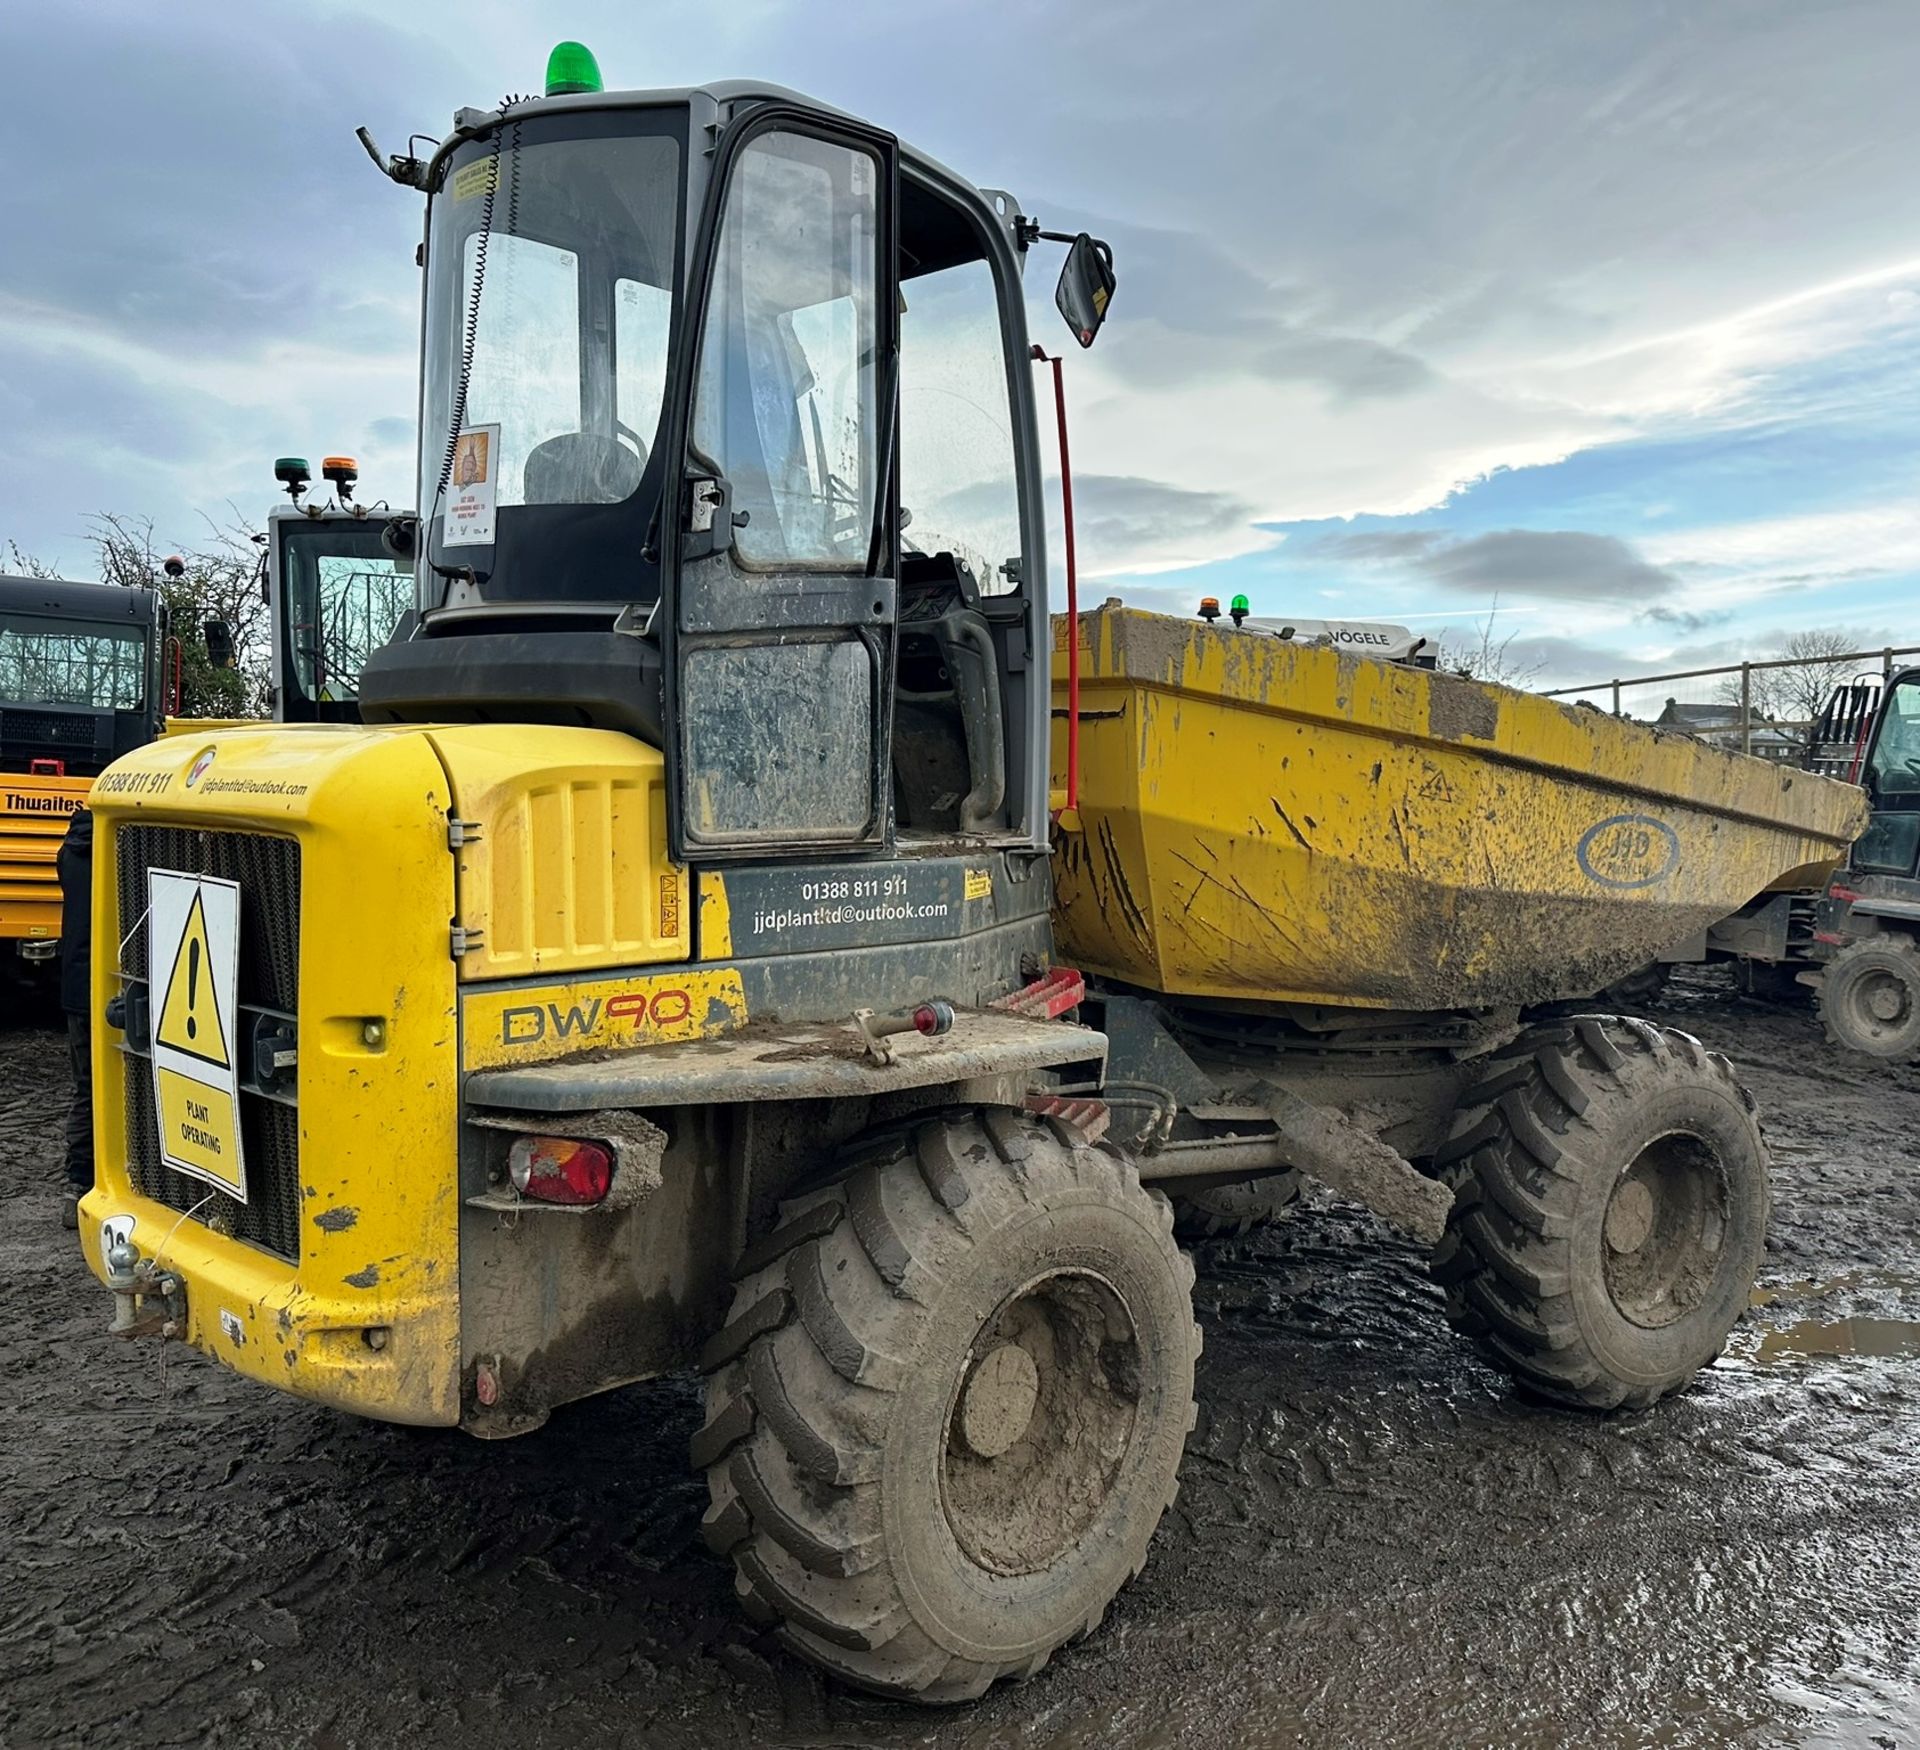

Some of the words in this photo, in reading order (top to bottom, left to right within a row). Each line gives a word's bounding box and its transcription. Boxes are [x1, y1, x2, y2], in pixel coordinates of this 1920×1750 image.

[1328, 629, 1391, 646] VÖGELE
[97, 773, 132, 793] 01388
[127, 772, 152, 793] 811
[147, 772, 173, 794] 911
[199, 777, 308, 796] jjdplantltd@outlook.com
[5, 794, 84, 812] Thwaites
[802, 881, 849, 901] 01388
[853, 880, 878, 898] 811
[883, 878, 908, 897] 911
[752, 900, 949, 935] jjdplantltd@outlook.com
[186, 1099, 209, 1125] PLANT
[181, 1122, 222, 1155] OPERATING
